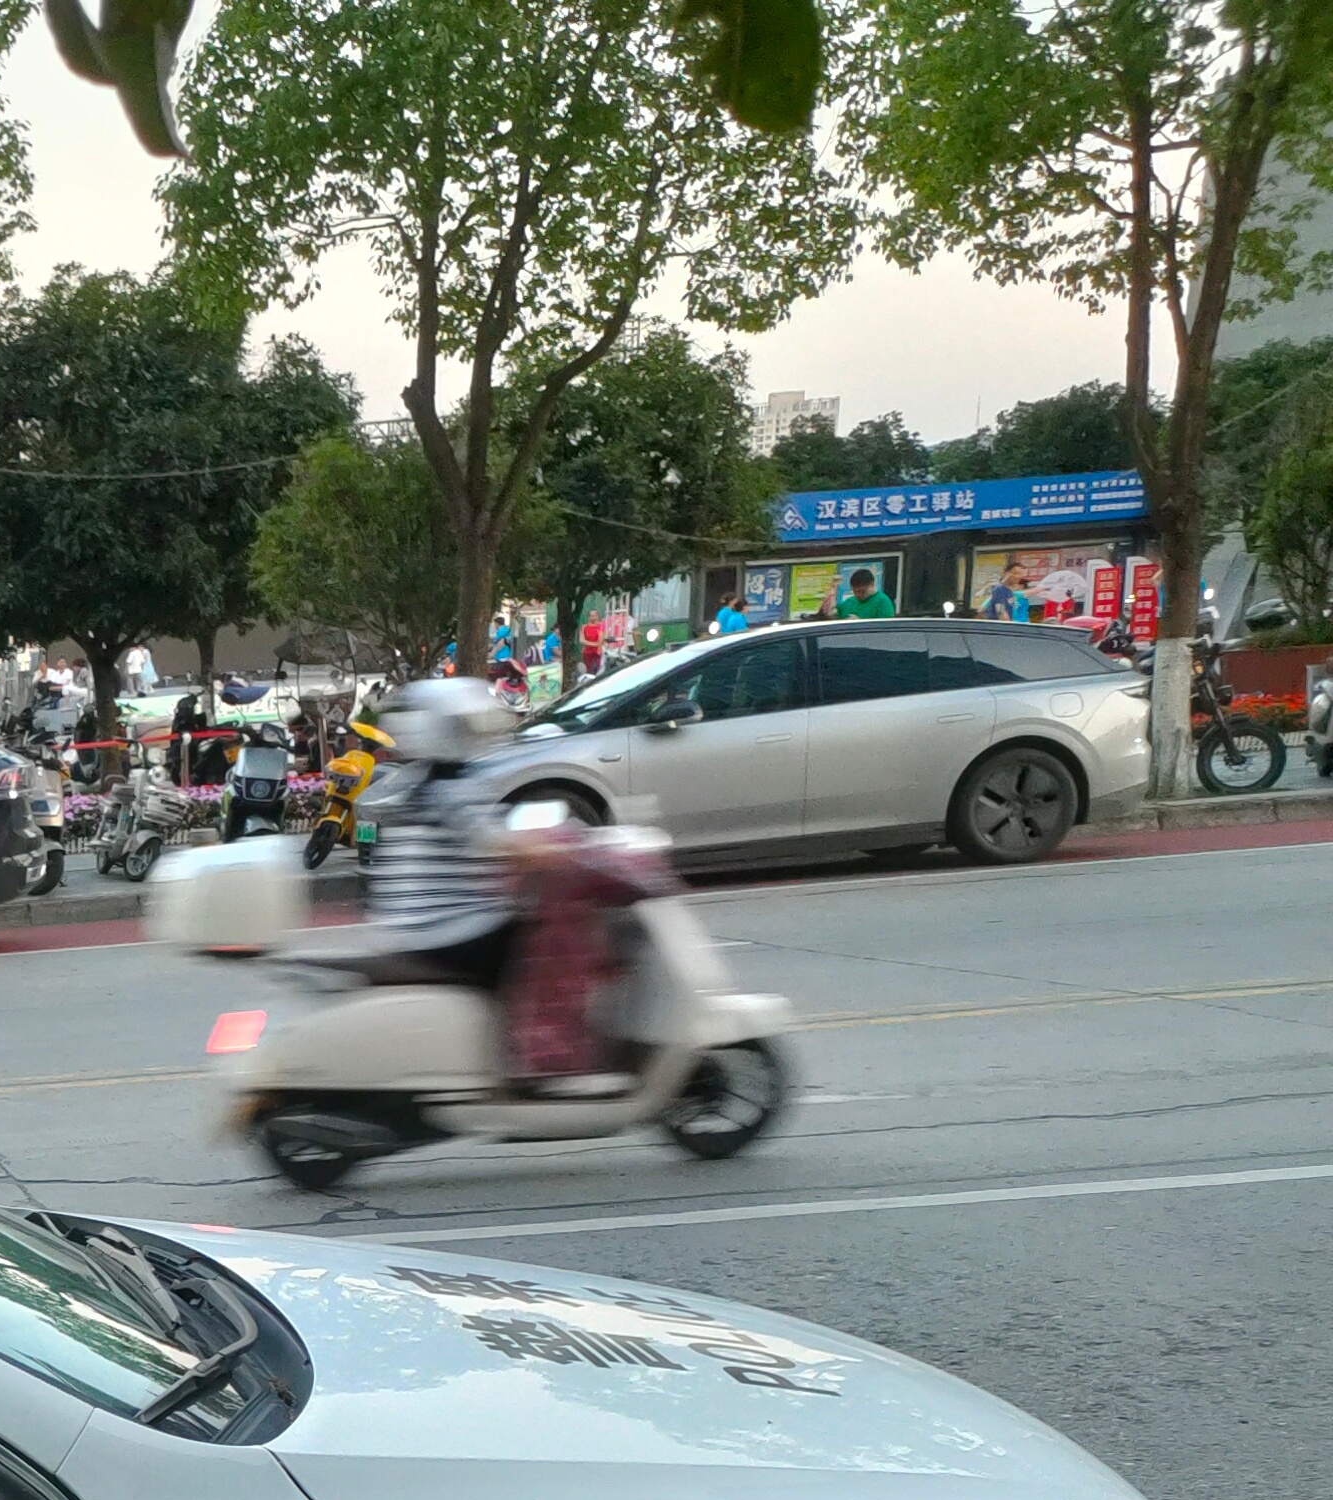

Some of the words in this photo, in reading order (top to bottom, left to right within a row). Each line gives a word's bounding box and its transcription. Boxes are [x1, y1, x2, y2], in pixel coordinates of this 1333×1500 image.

[815, 489, 975, 520] 汉滨区零工驿站
[375, 1265, 695, 1371] 警察
[581, 1286, 842, 1397] POLICE
